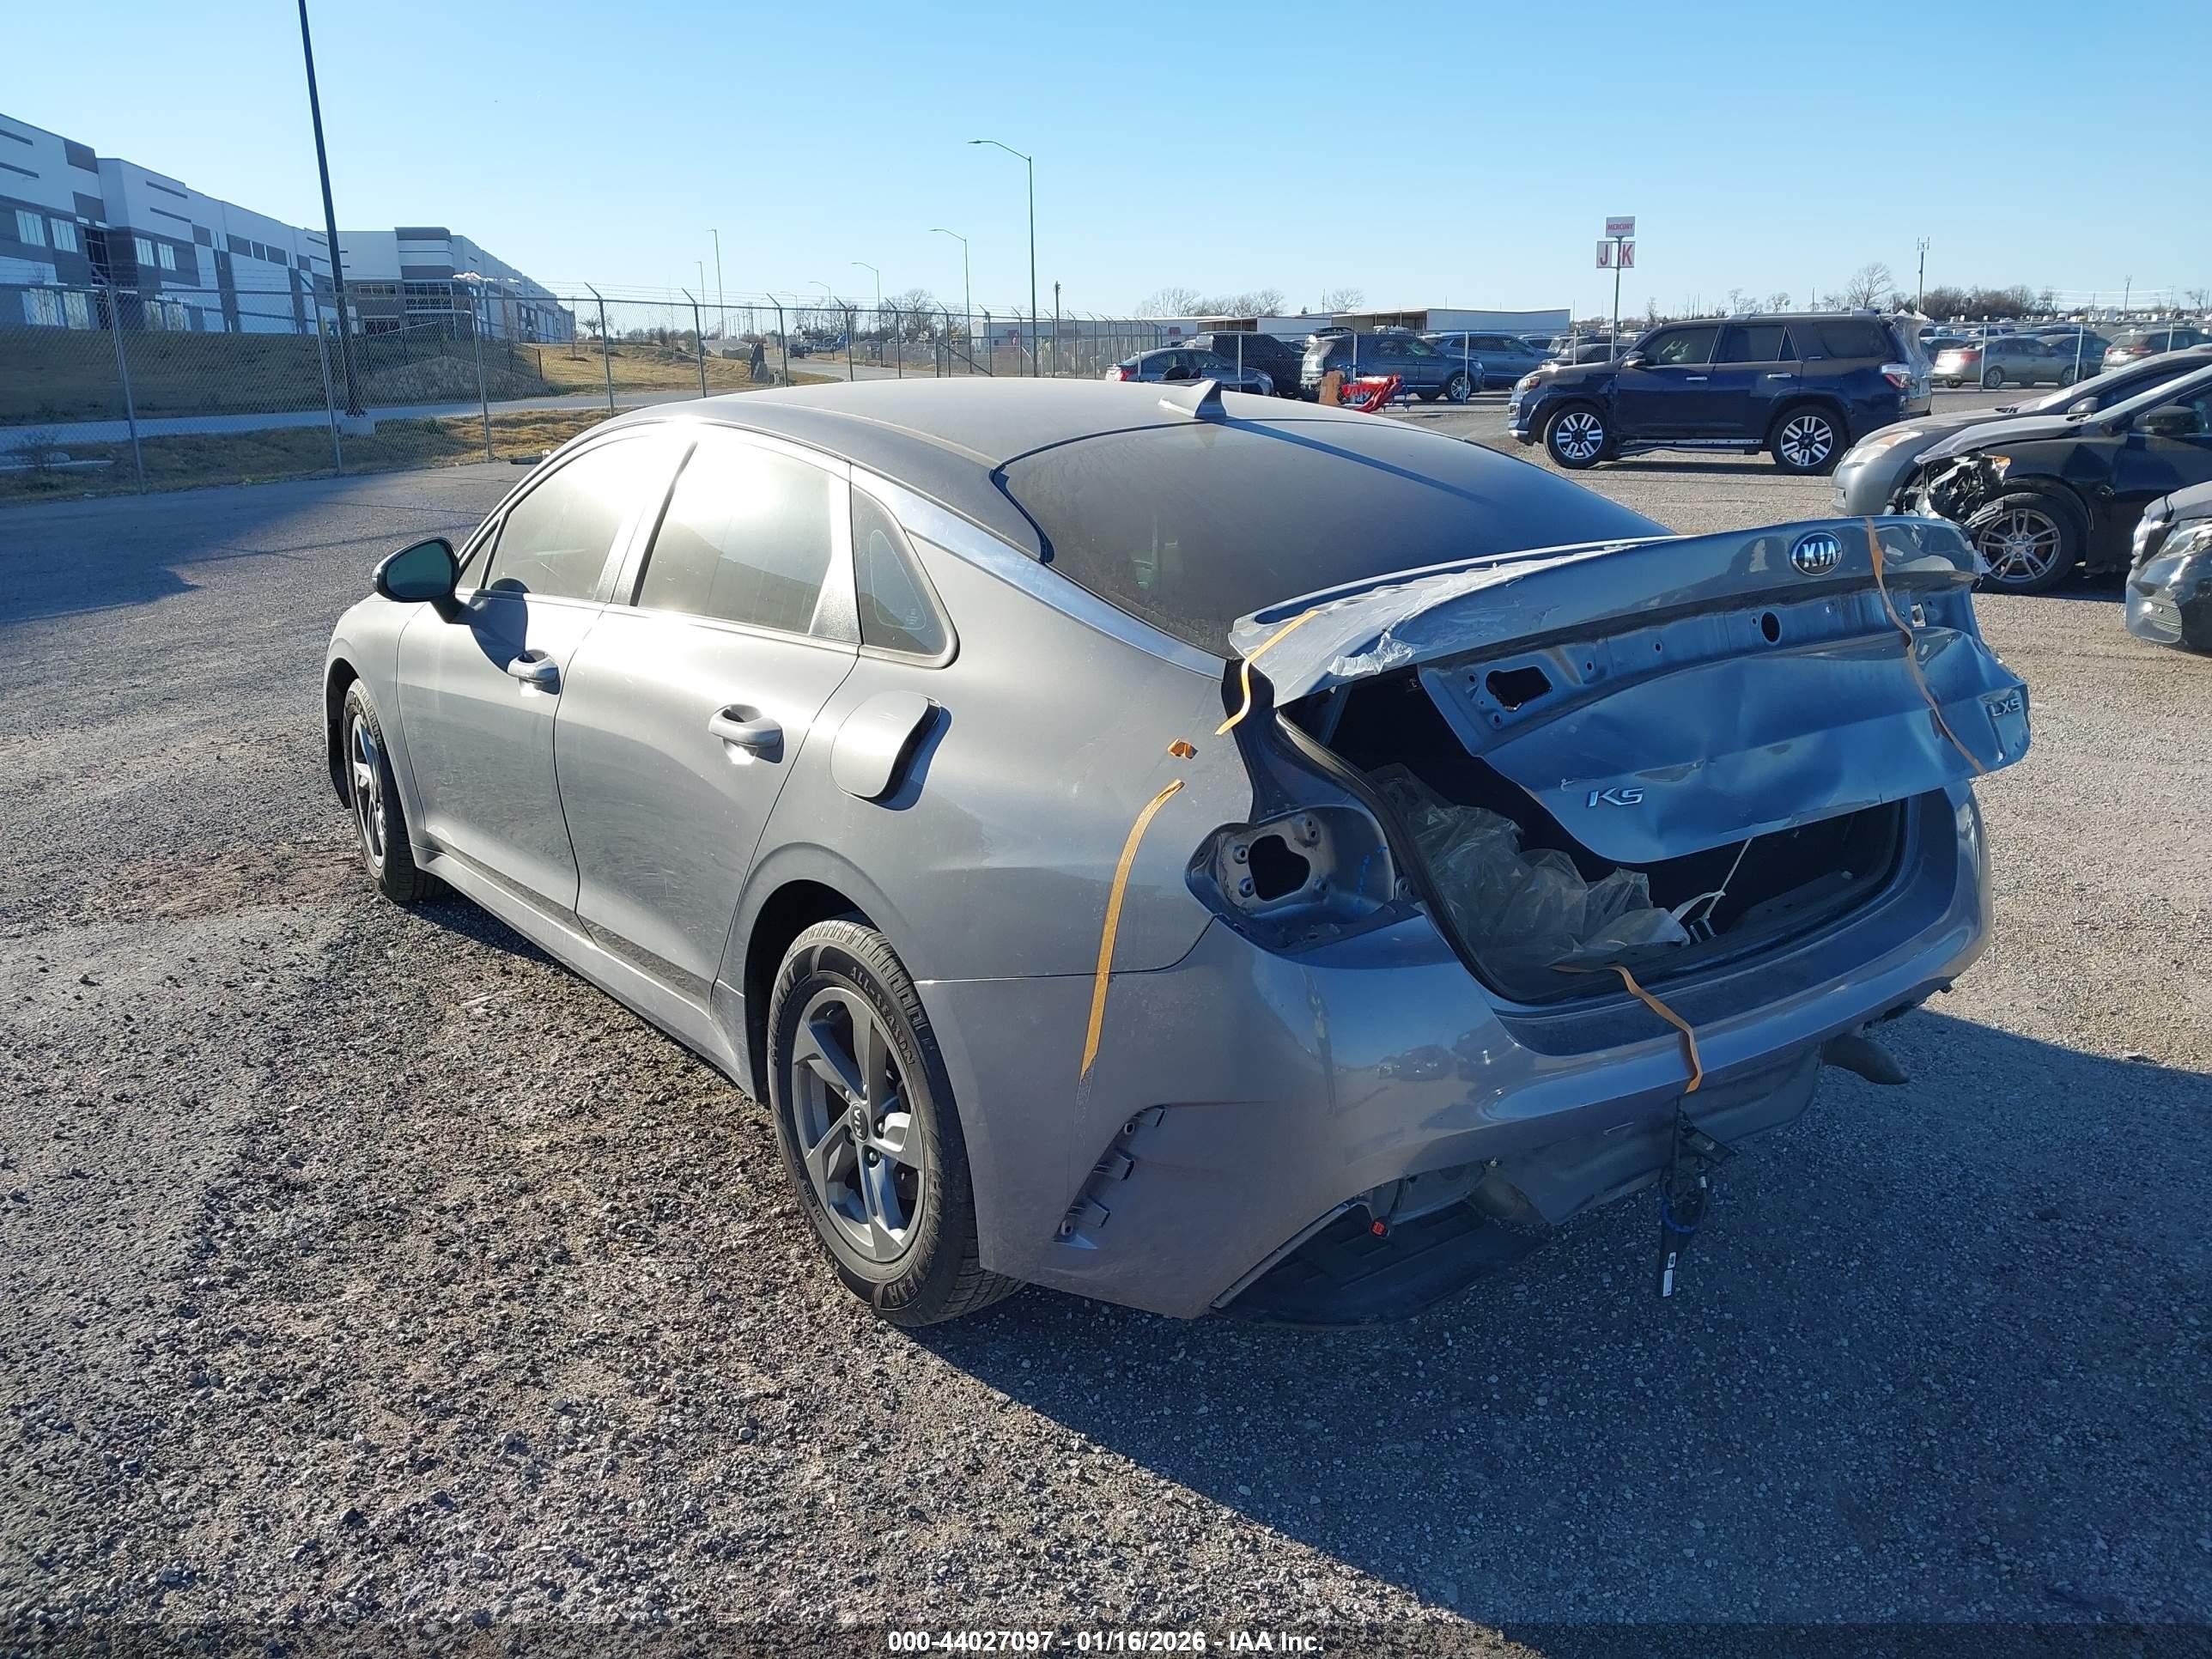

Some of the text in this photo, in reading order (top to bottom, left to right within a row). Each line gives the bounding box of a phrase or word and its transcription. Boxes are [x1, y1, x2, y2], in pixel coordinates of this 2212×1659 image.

[1600, 244, 1633, 265] J K
[1802, 541, 1837, 568] KIA
[1589, 786, 1644, 807] K5
[854, 1109, 866, 1138] KIA
